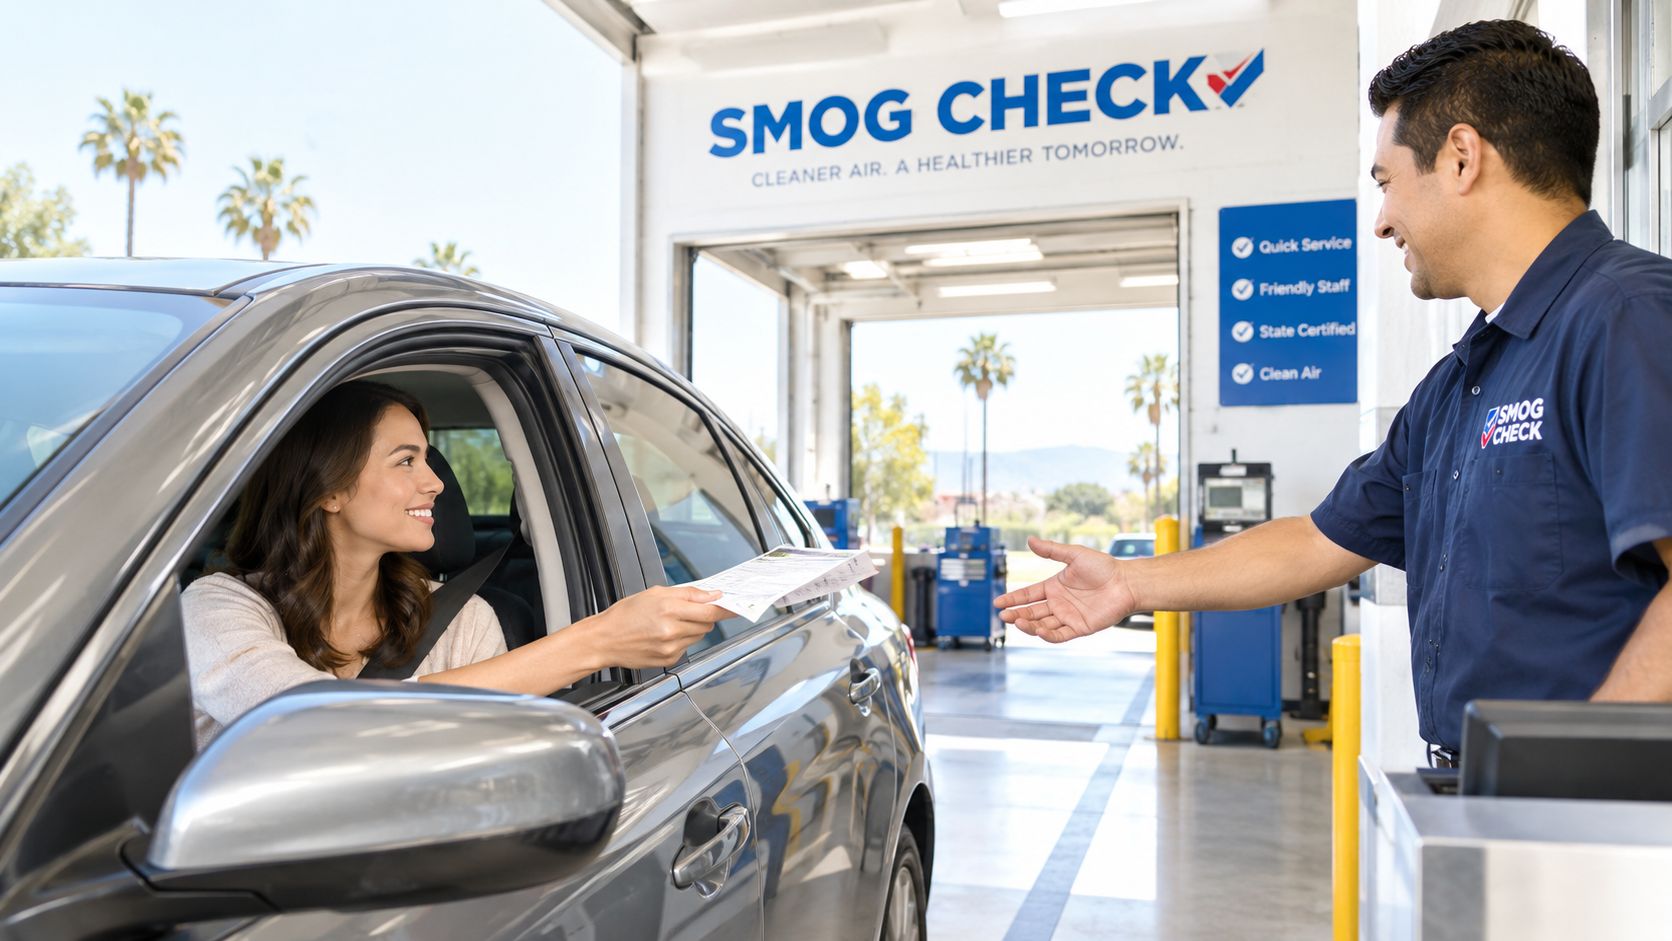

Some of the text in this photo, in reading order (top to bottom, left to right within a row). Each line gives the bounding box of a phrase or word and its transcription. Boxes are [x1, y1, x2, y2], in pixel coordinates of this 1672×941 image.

[709, 55, 1209, 158] SMOG CHECK
[752, 134, 1184, 188] CLEANER AIR. A HEALTHIER TOMORROW.
[1259, 236, 1352, 254] Quick Service
[1259, 279, 1351, 297] Friendly Staff
[1259, 322, 1356, 339] State Certified
[1259, 366, 1322, 381] Clean Air
[1498, 398, 1544, 425] SMOG
[1493, 421, 1543, 445] CHECK
